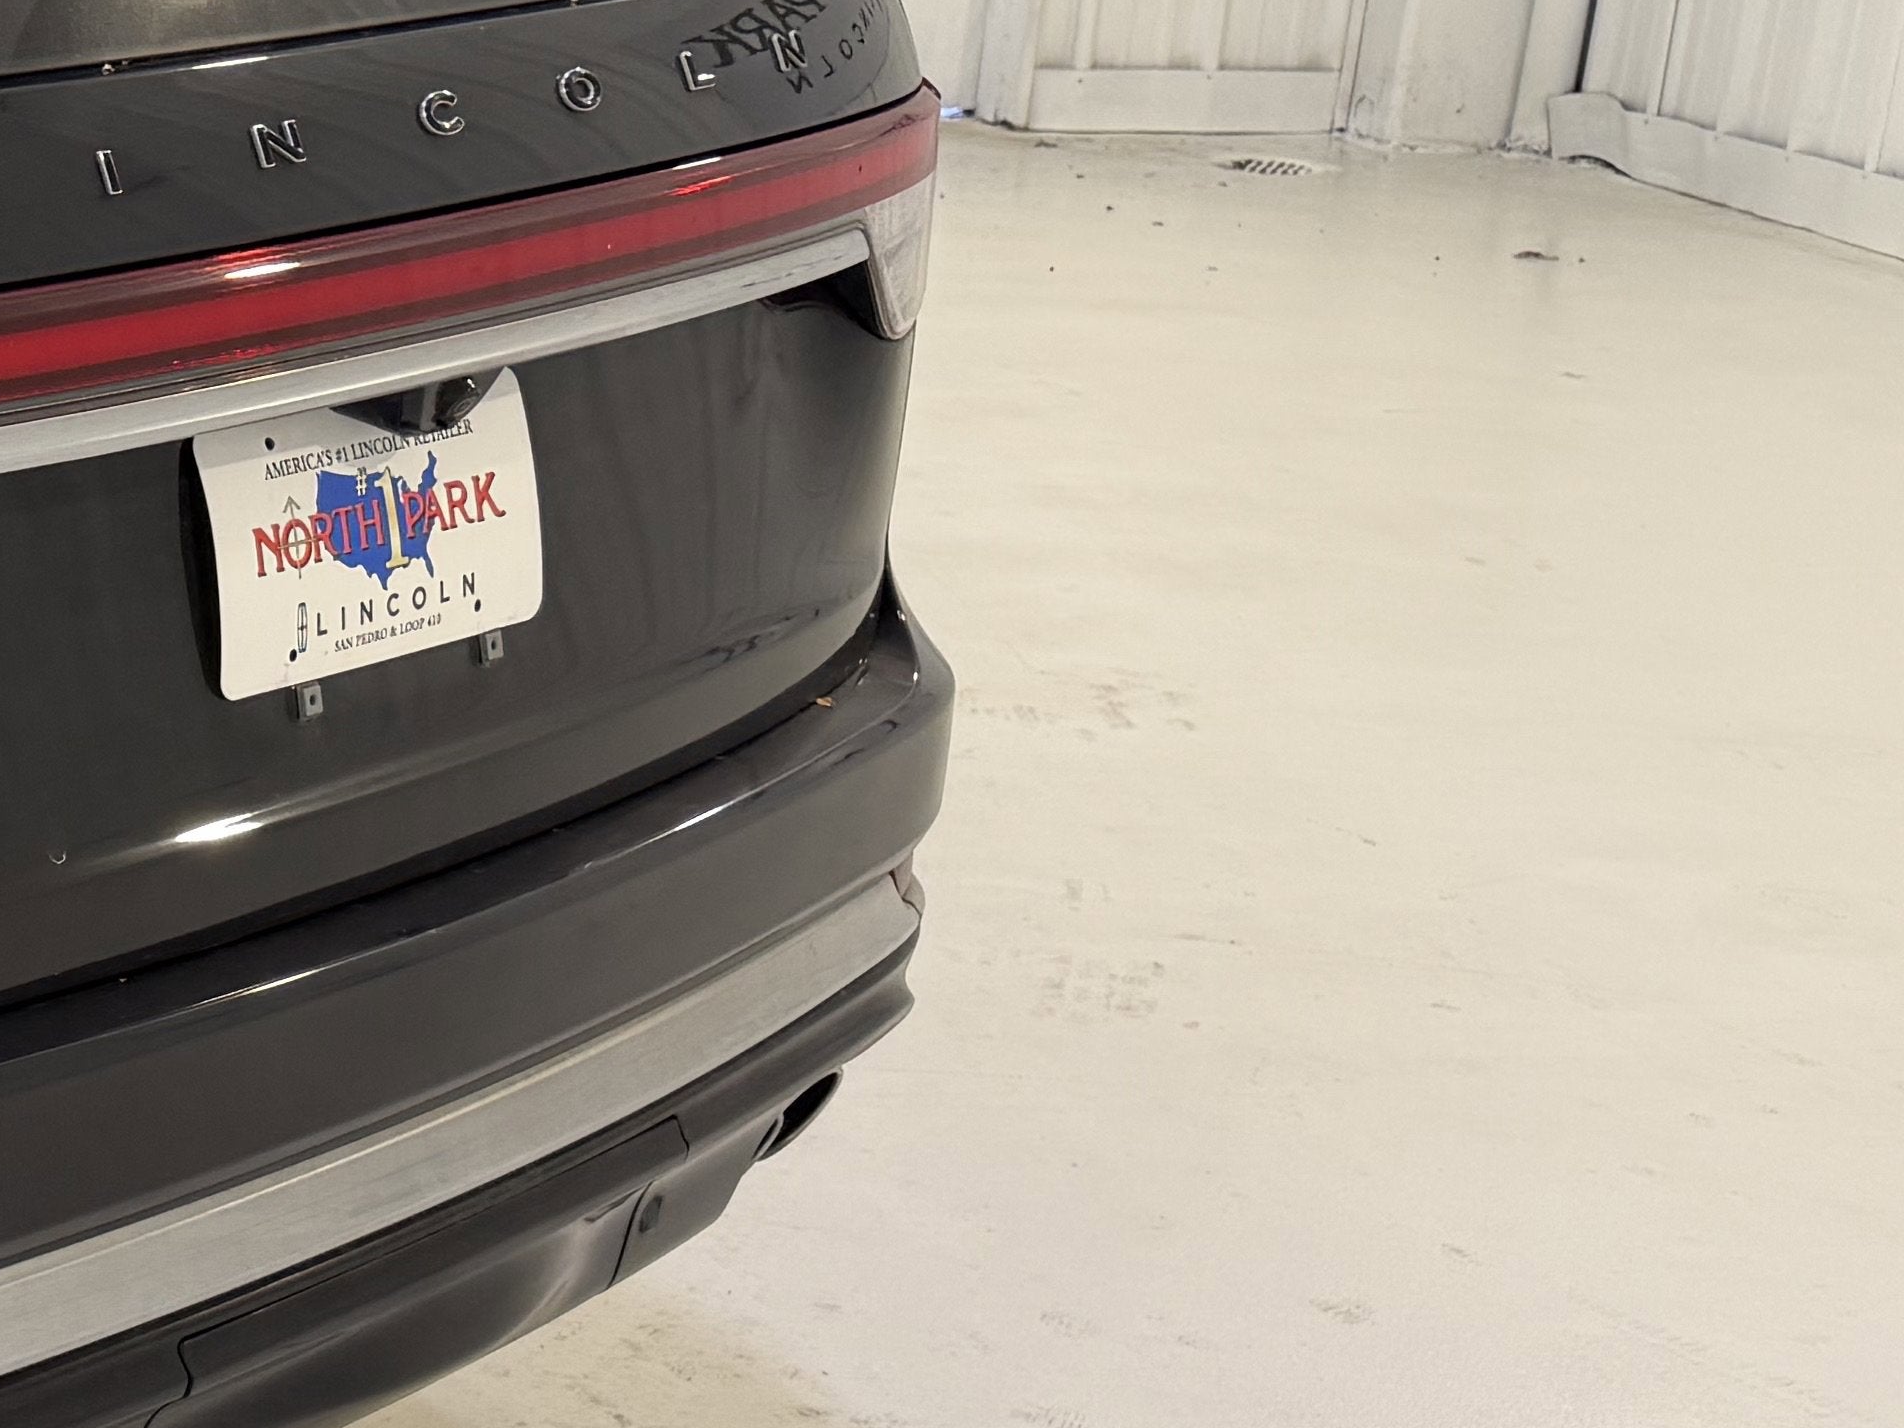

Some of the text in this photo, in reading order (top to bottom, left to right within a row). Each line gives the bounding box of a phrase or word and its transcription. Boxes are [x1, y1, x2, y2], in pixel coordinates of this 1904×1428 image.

[264, 449, 333, 480] AMERICA'S
[335, 447, 349, 463] #1
[351, 434, 410, 460] LINCOLN
[252, 499, 386, 578] NORTH
[401, 471, 506, 539] PARK
[316, 572, 476, 637] LINCOLN
[334, 637, 353, 652] SAN
[355, 627, 388, 647] PEDRO
[399, 617, 425, 635] LOOP
